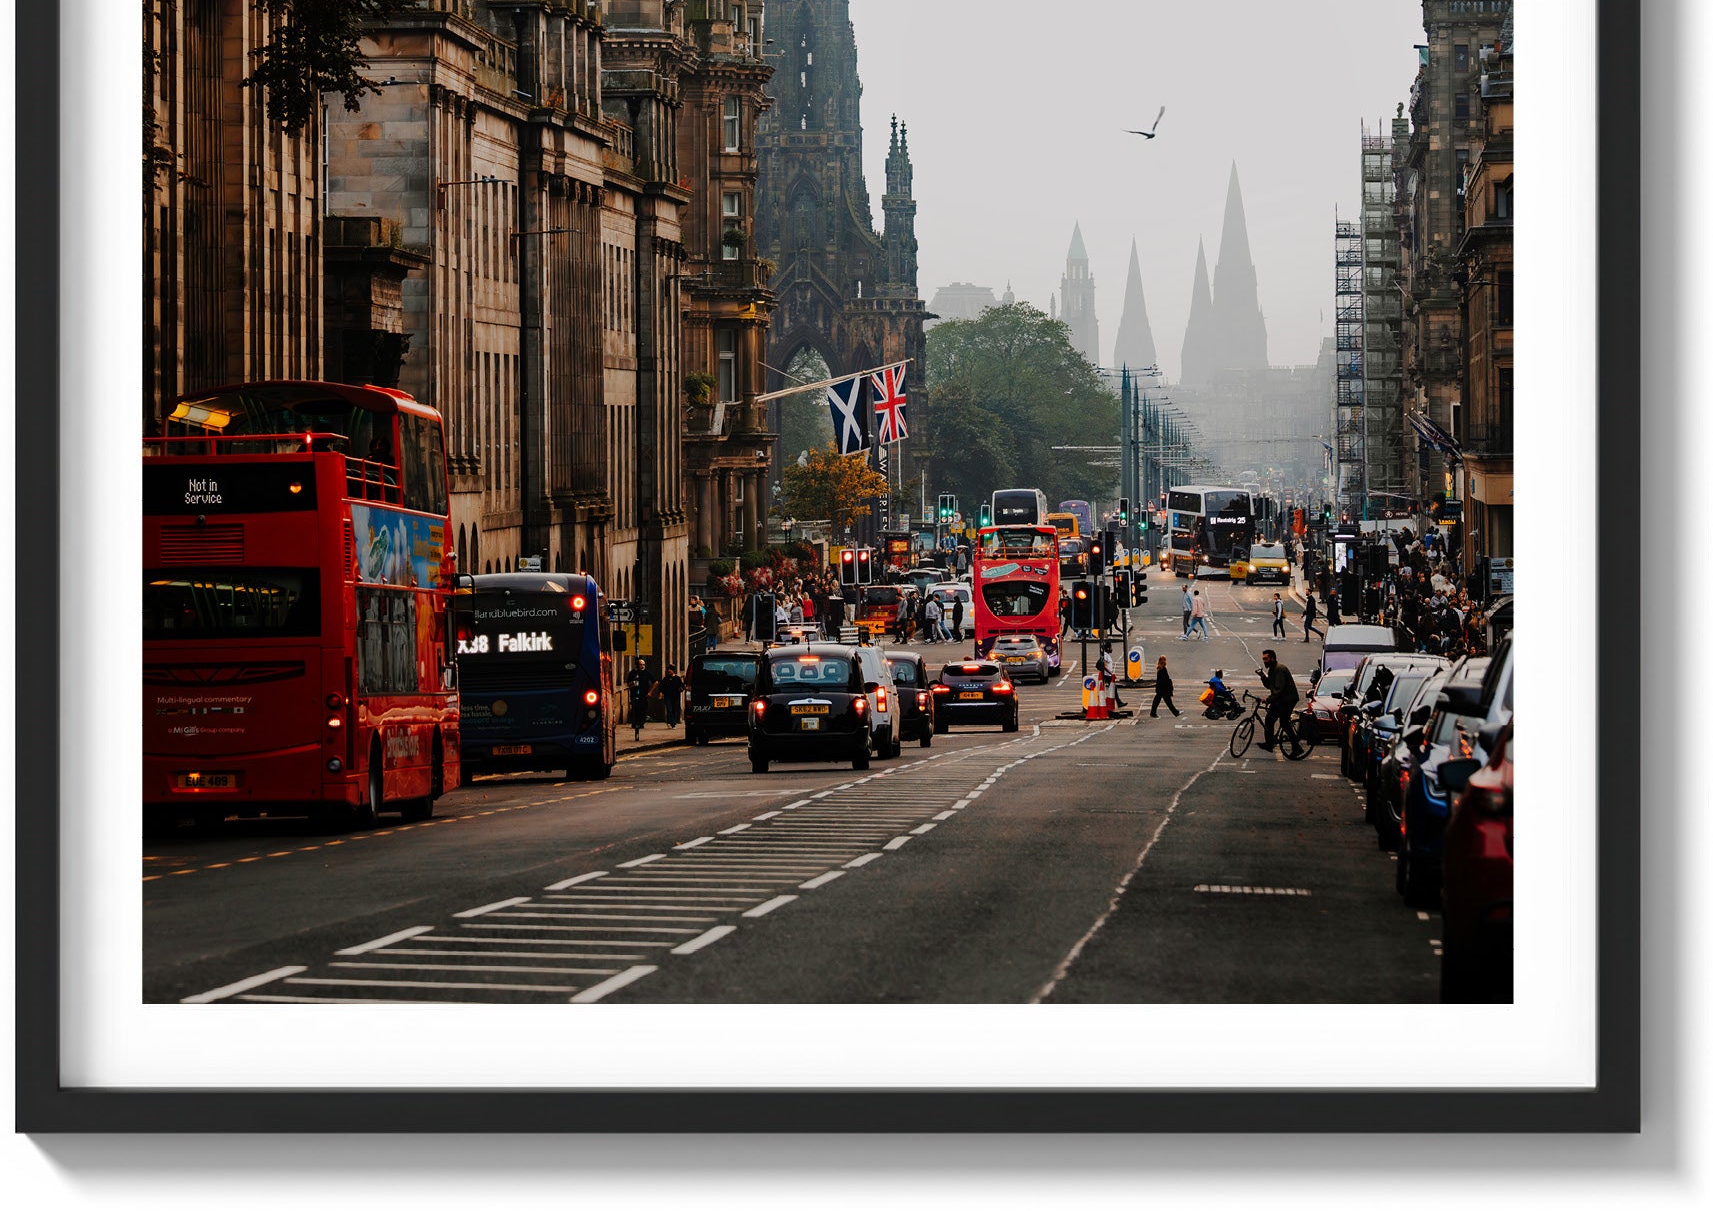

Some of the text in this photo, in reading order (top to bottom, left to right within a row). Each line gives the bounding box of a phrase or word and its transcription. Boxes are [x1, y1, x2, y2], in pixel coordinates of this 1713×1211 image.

[189, 478, 218, 492] Not in
[184, 492, 223, 504] Service
[1236, 516, 1246, 524] 25
[498, 631, 554, 652] Falkirk
[157, 696, 252, 705] Multi-lingual commentary
